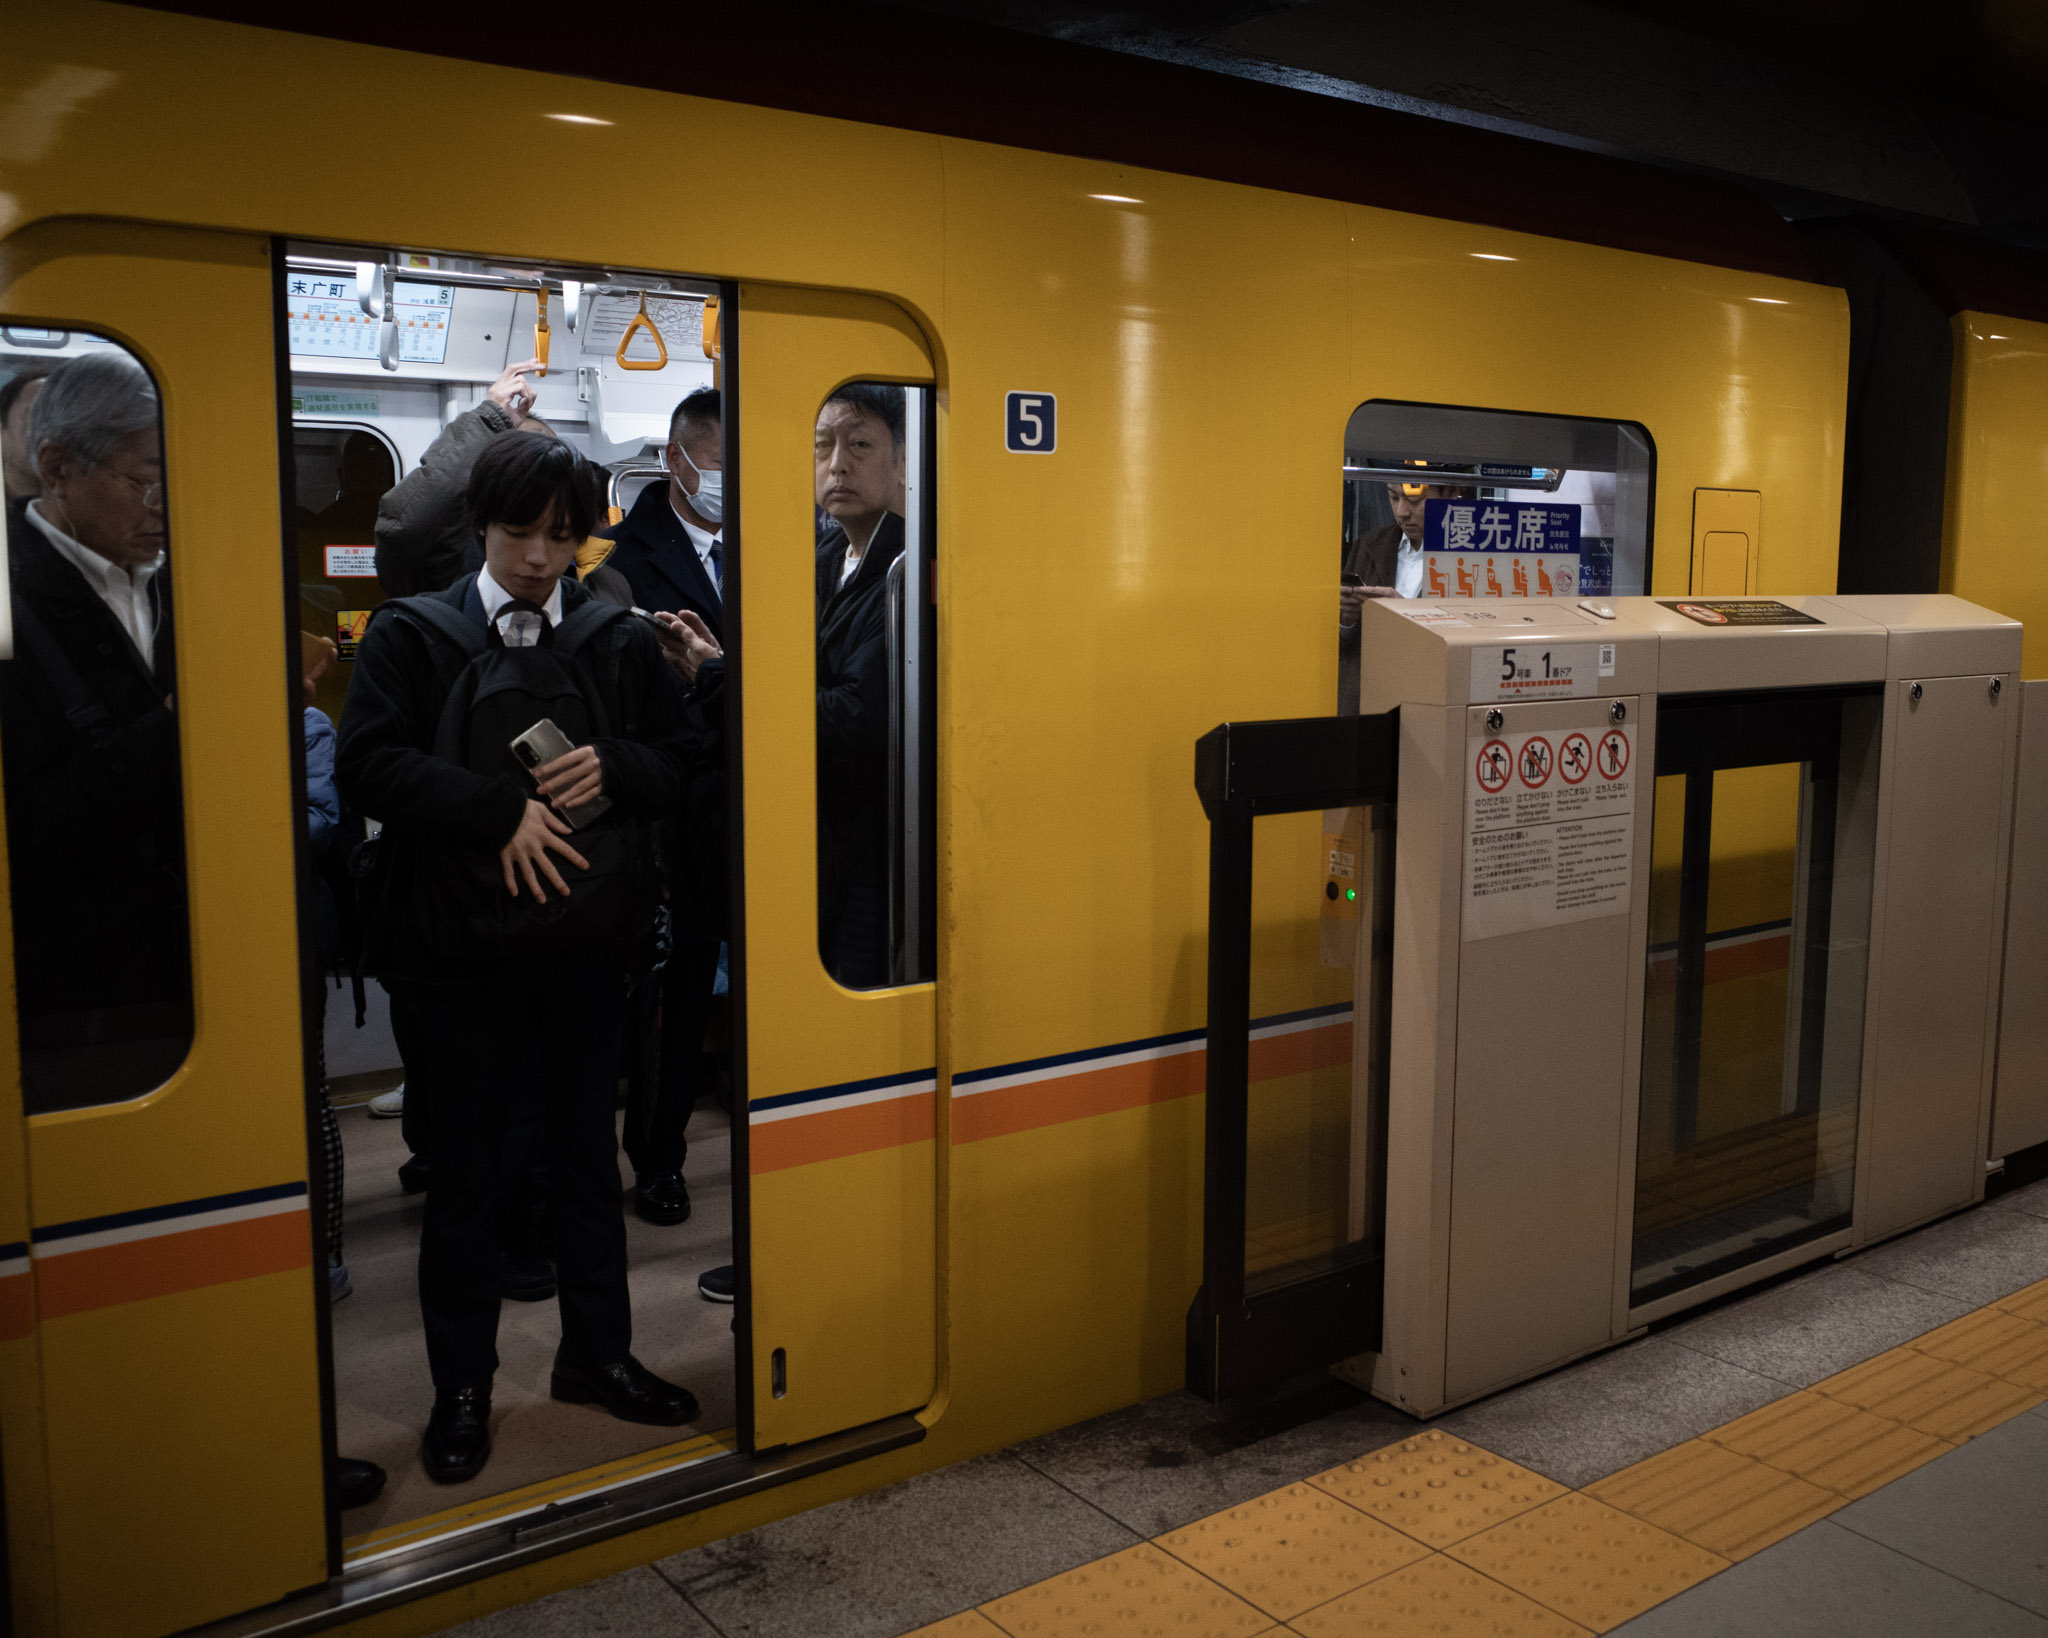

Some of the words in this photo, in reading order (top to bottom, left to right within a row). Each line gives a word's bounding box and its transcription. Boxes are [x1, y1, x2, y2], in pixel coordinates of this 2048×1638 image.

[291, 280, 346, 298] 末广町
[440, 290, 449, 300] 5
[1019, 398, 1043, 447] 5
[1550, 511, 1570, 520] Priority
[1441, 504, 1548, 551] 優先席
[1502, 648, 1531, 681] 5号車
[1542, 652, 1572, 678] 1番ドア
[1557, 786, 1591, 798] かけこまない
[1595, 783, 1628, 794] 立ち入らない
[1516, 791, 1553, 803] 立てかけない
[1557, 825, 1582, 833] ATTENTION
